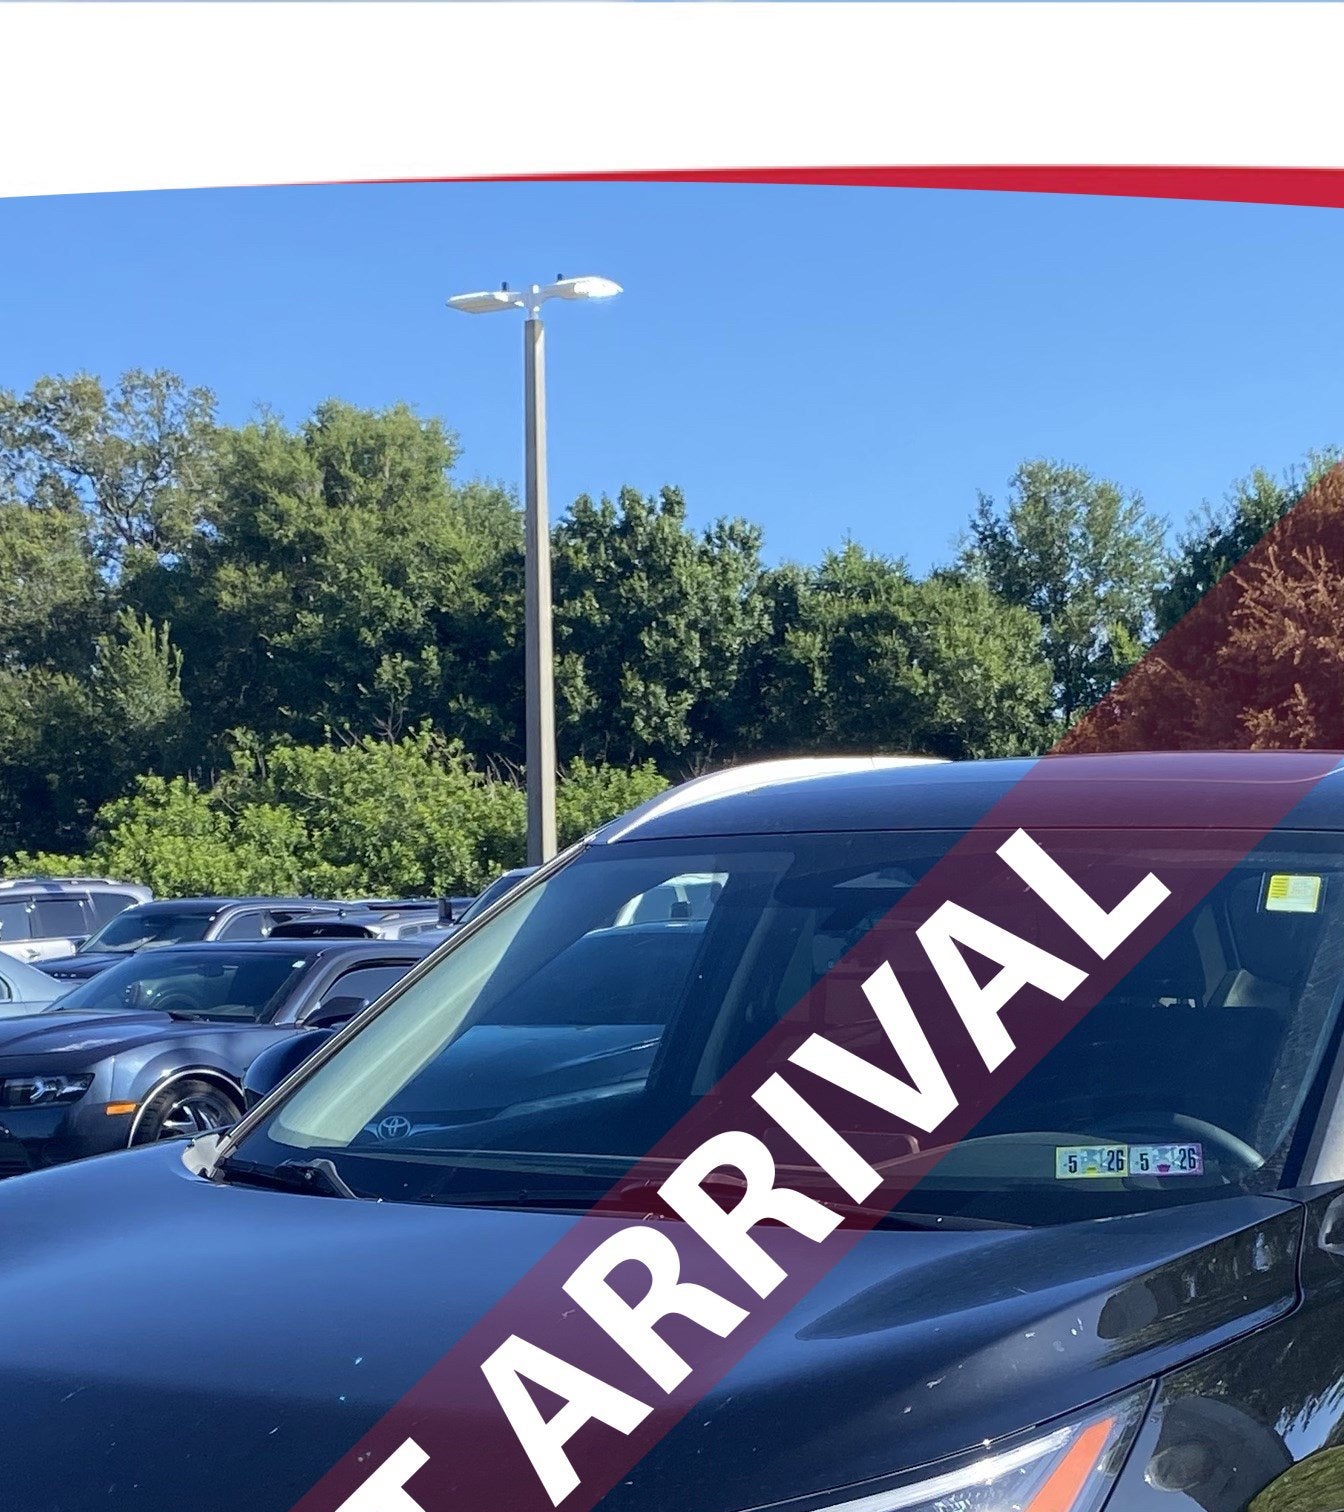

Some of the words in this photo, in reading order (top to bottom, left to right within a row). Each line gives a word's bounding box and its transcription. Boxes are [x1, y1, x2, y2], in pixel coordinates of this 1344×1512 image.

[1067, 1154, 1078, 1174] 5
[1106, 1149, 1125, 1172] 26
[1139, 1152, 1150, 1172] 5
[1178, 1148, 1197, 1171] 26
